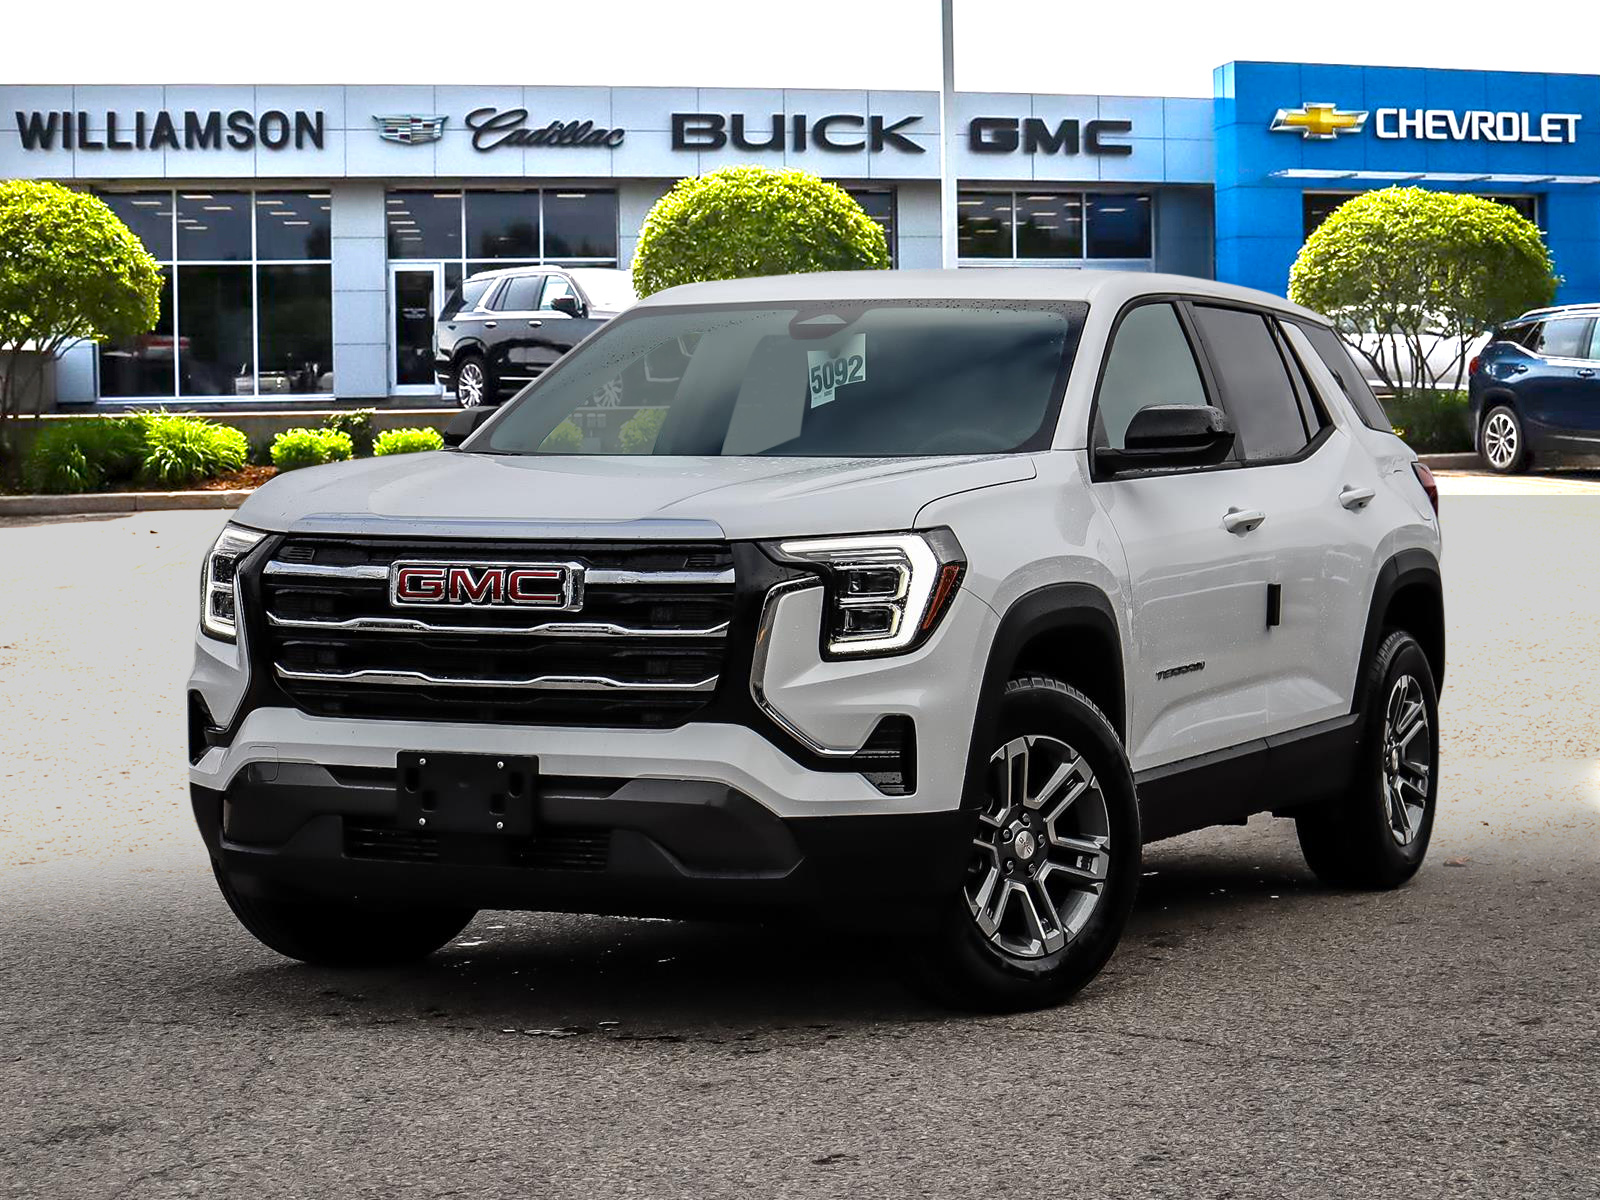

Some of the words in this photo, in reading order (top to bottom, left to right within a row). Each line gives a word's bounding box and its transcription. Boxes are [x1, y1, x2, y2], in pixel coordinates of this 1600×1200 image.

[15, 111, 324, 151] WILLIAMSON
[465, 107, 625, 153] Cadillac
[671, 113, 926, 153] BUICK
[969, 117, 1133, 156] GMC
[1376, 108, 1582, 143] CHEVROLET
[811, 355, 863, 394] 5092
[398, 568, 561, 604] GMC
